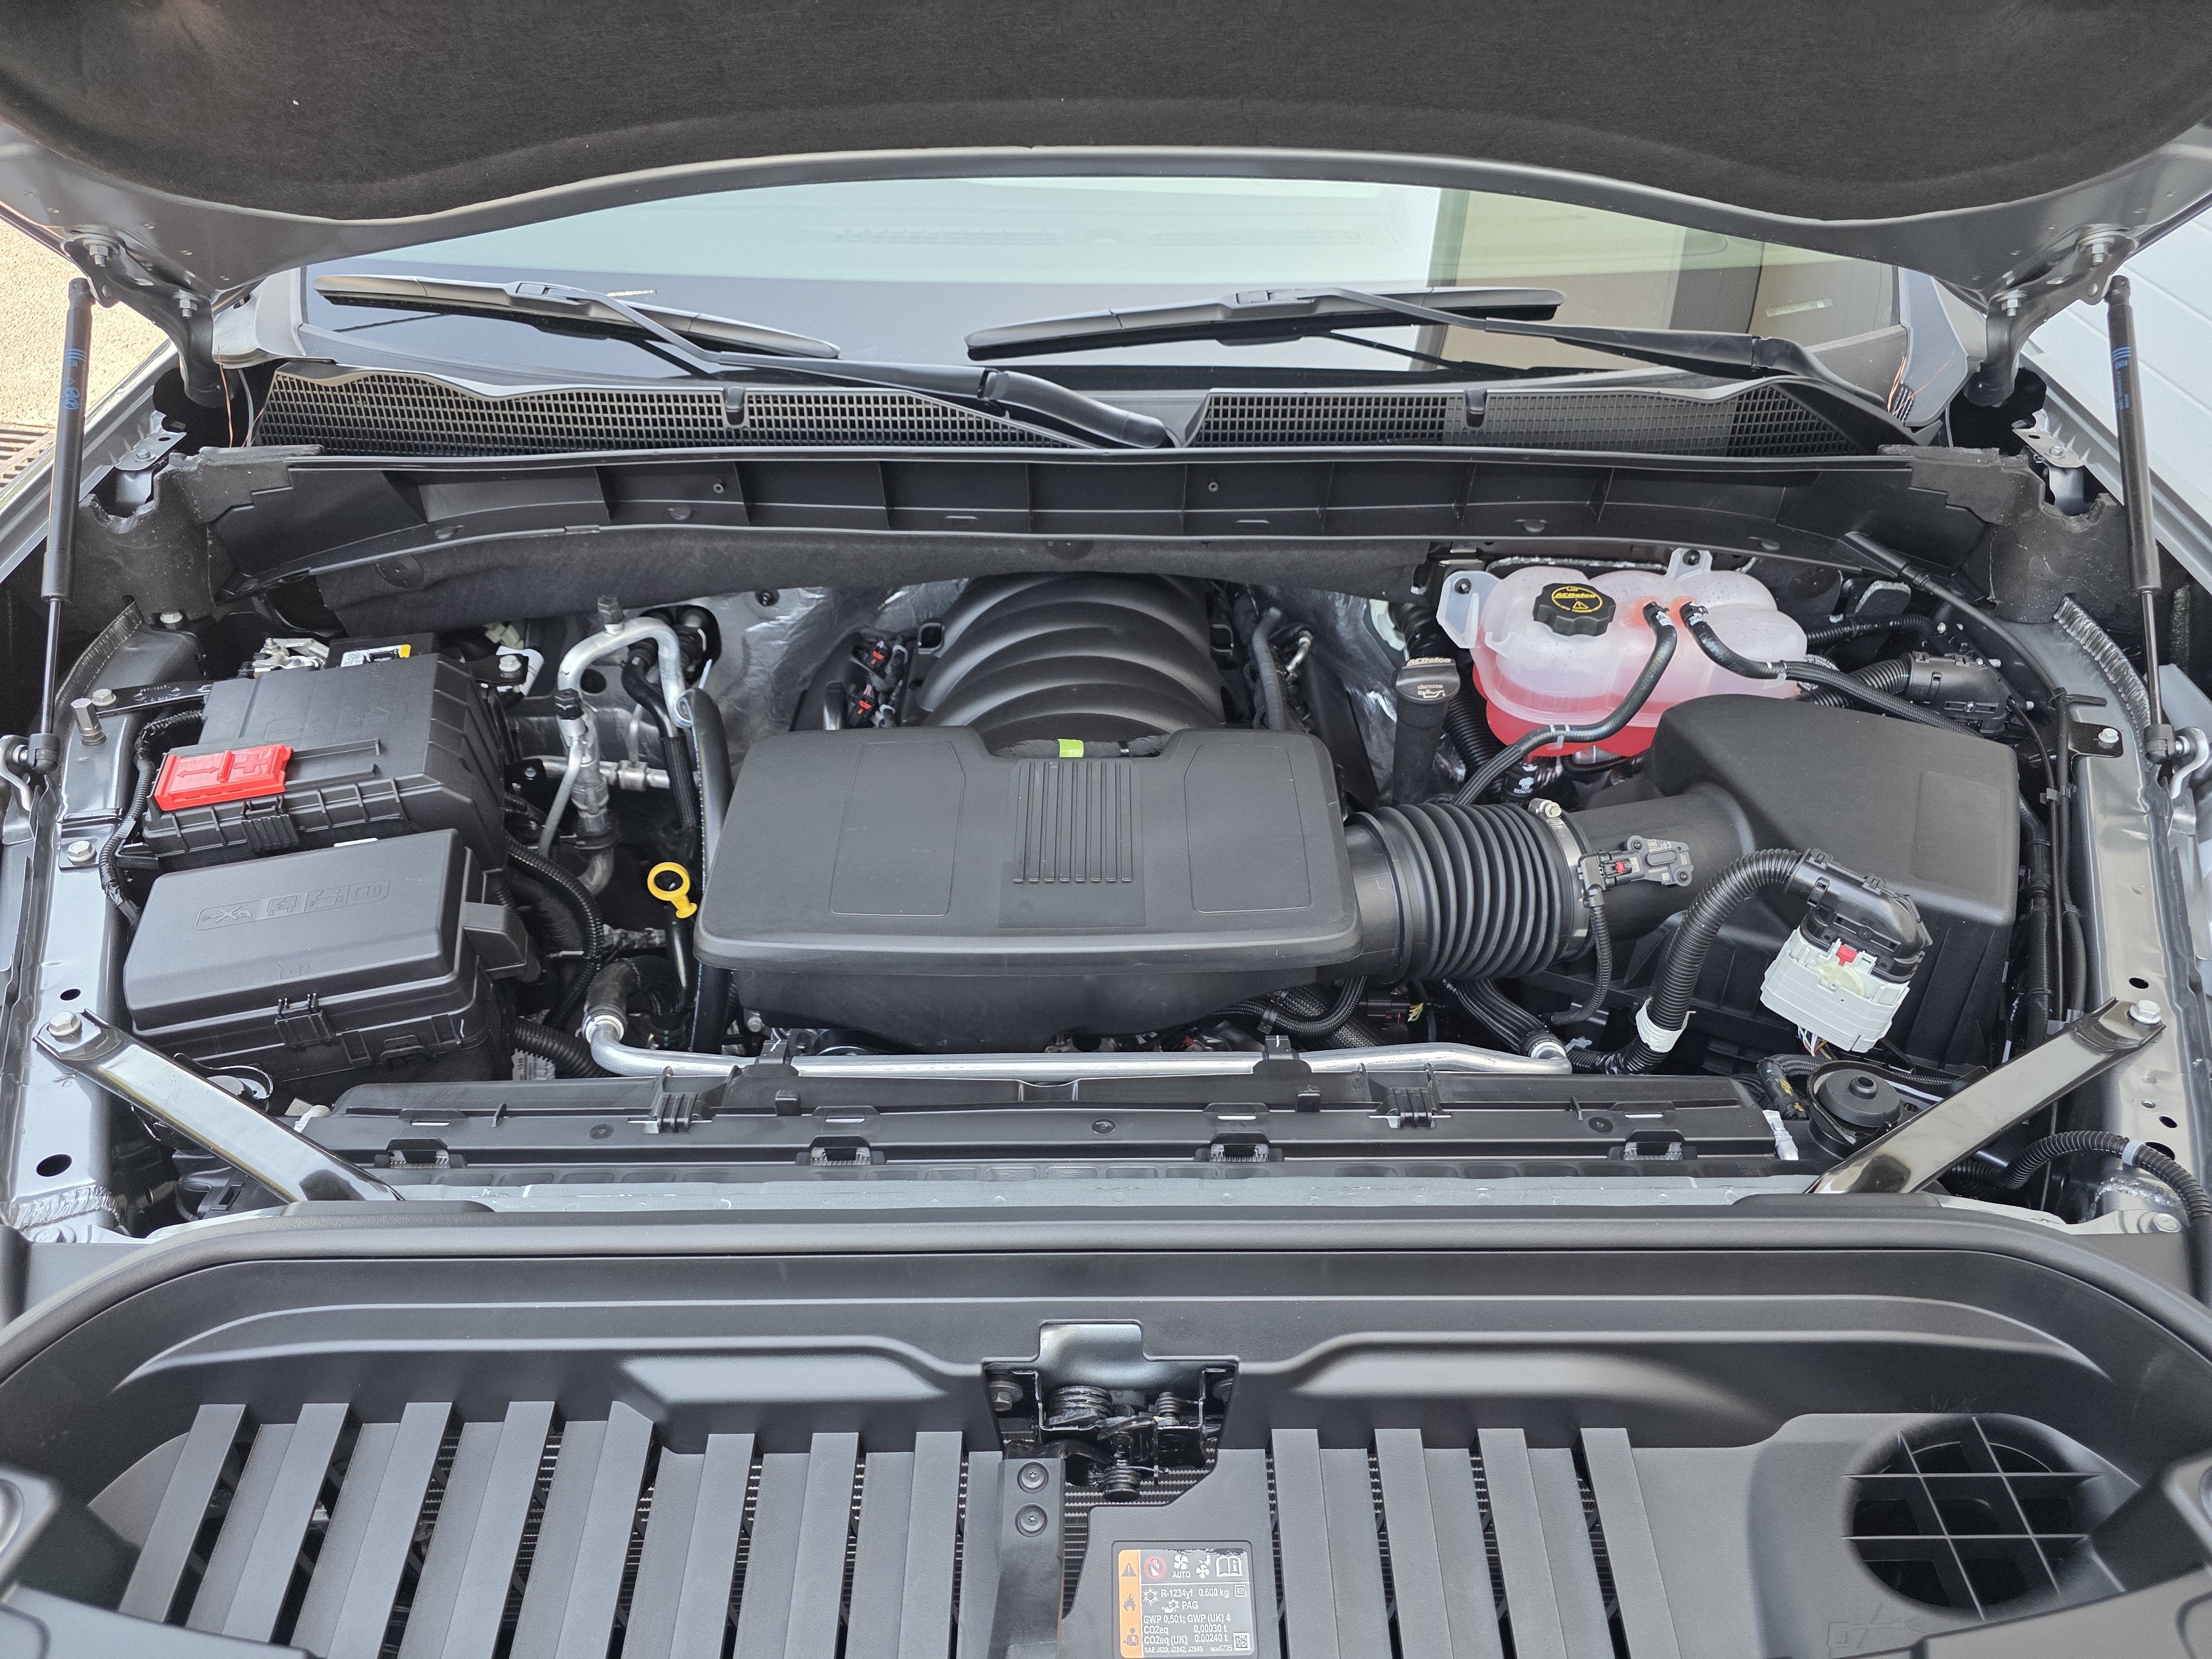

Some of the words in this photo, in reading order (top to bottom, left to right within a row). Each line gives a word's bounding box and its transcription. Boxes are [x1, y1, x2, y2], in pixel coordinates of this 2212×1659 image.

[1406, 657, 1451, 667] ACDelco
[1172, 1571, 1191, 1579] AUTO
[1161, 1588, 1194, 1599] R-1234yf
[1198, 1588, 1218, 1597] 0.600
[1220, 1588, 1229, 1598] kg
[1182, 1600, 1198, 1609] PAG
[1143, 1615, 1162, 1624] GWP
[1164, 1614, 1185, 1624] 0,501;
[1187, 1614, 1206, 1623] GWP
[1208, 1613, 1224, 1624] (UK)
[1225, 1613, 1231, 1622] 4
[1143, 1625, 1168, 1635] CO2eq
[1194, 1624, 1221, 1634] 0,00030
[1223, 1624, 1228, 1632] t
[1144, 1635, 1169, 1646] CO2eq
[1171, 1635, 1187, 1646] (UK)
[1194, 1633, 1223, 1642] 0.00240
[1224, 1634, 1228, 1642] t
